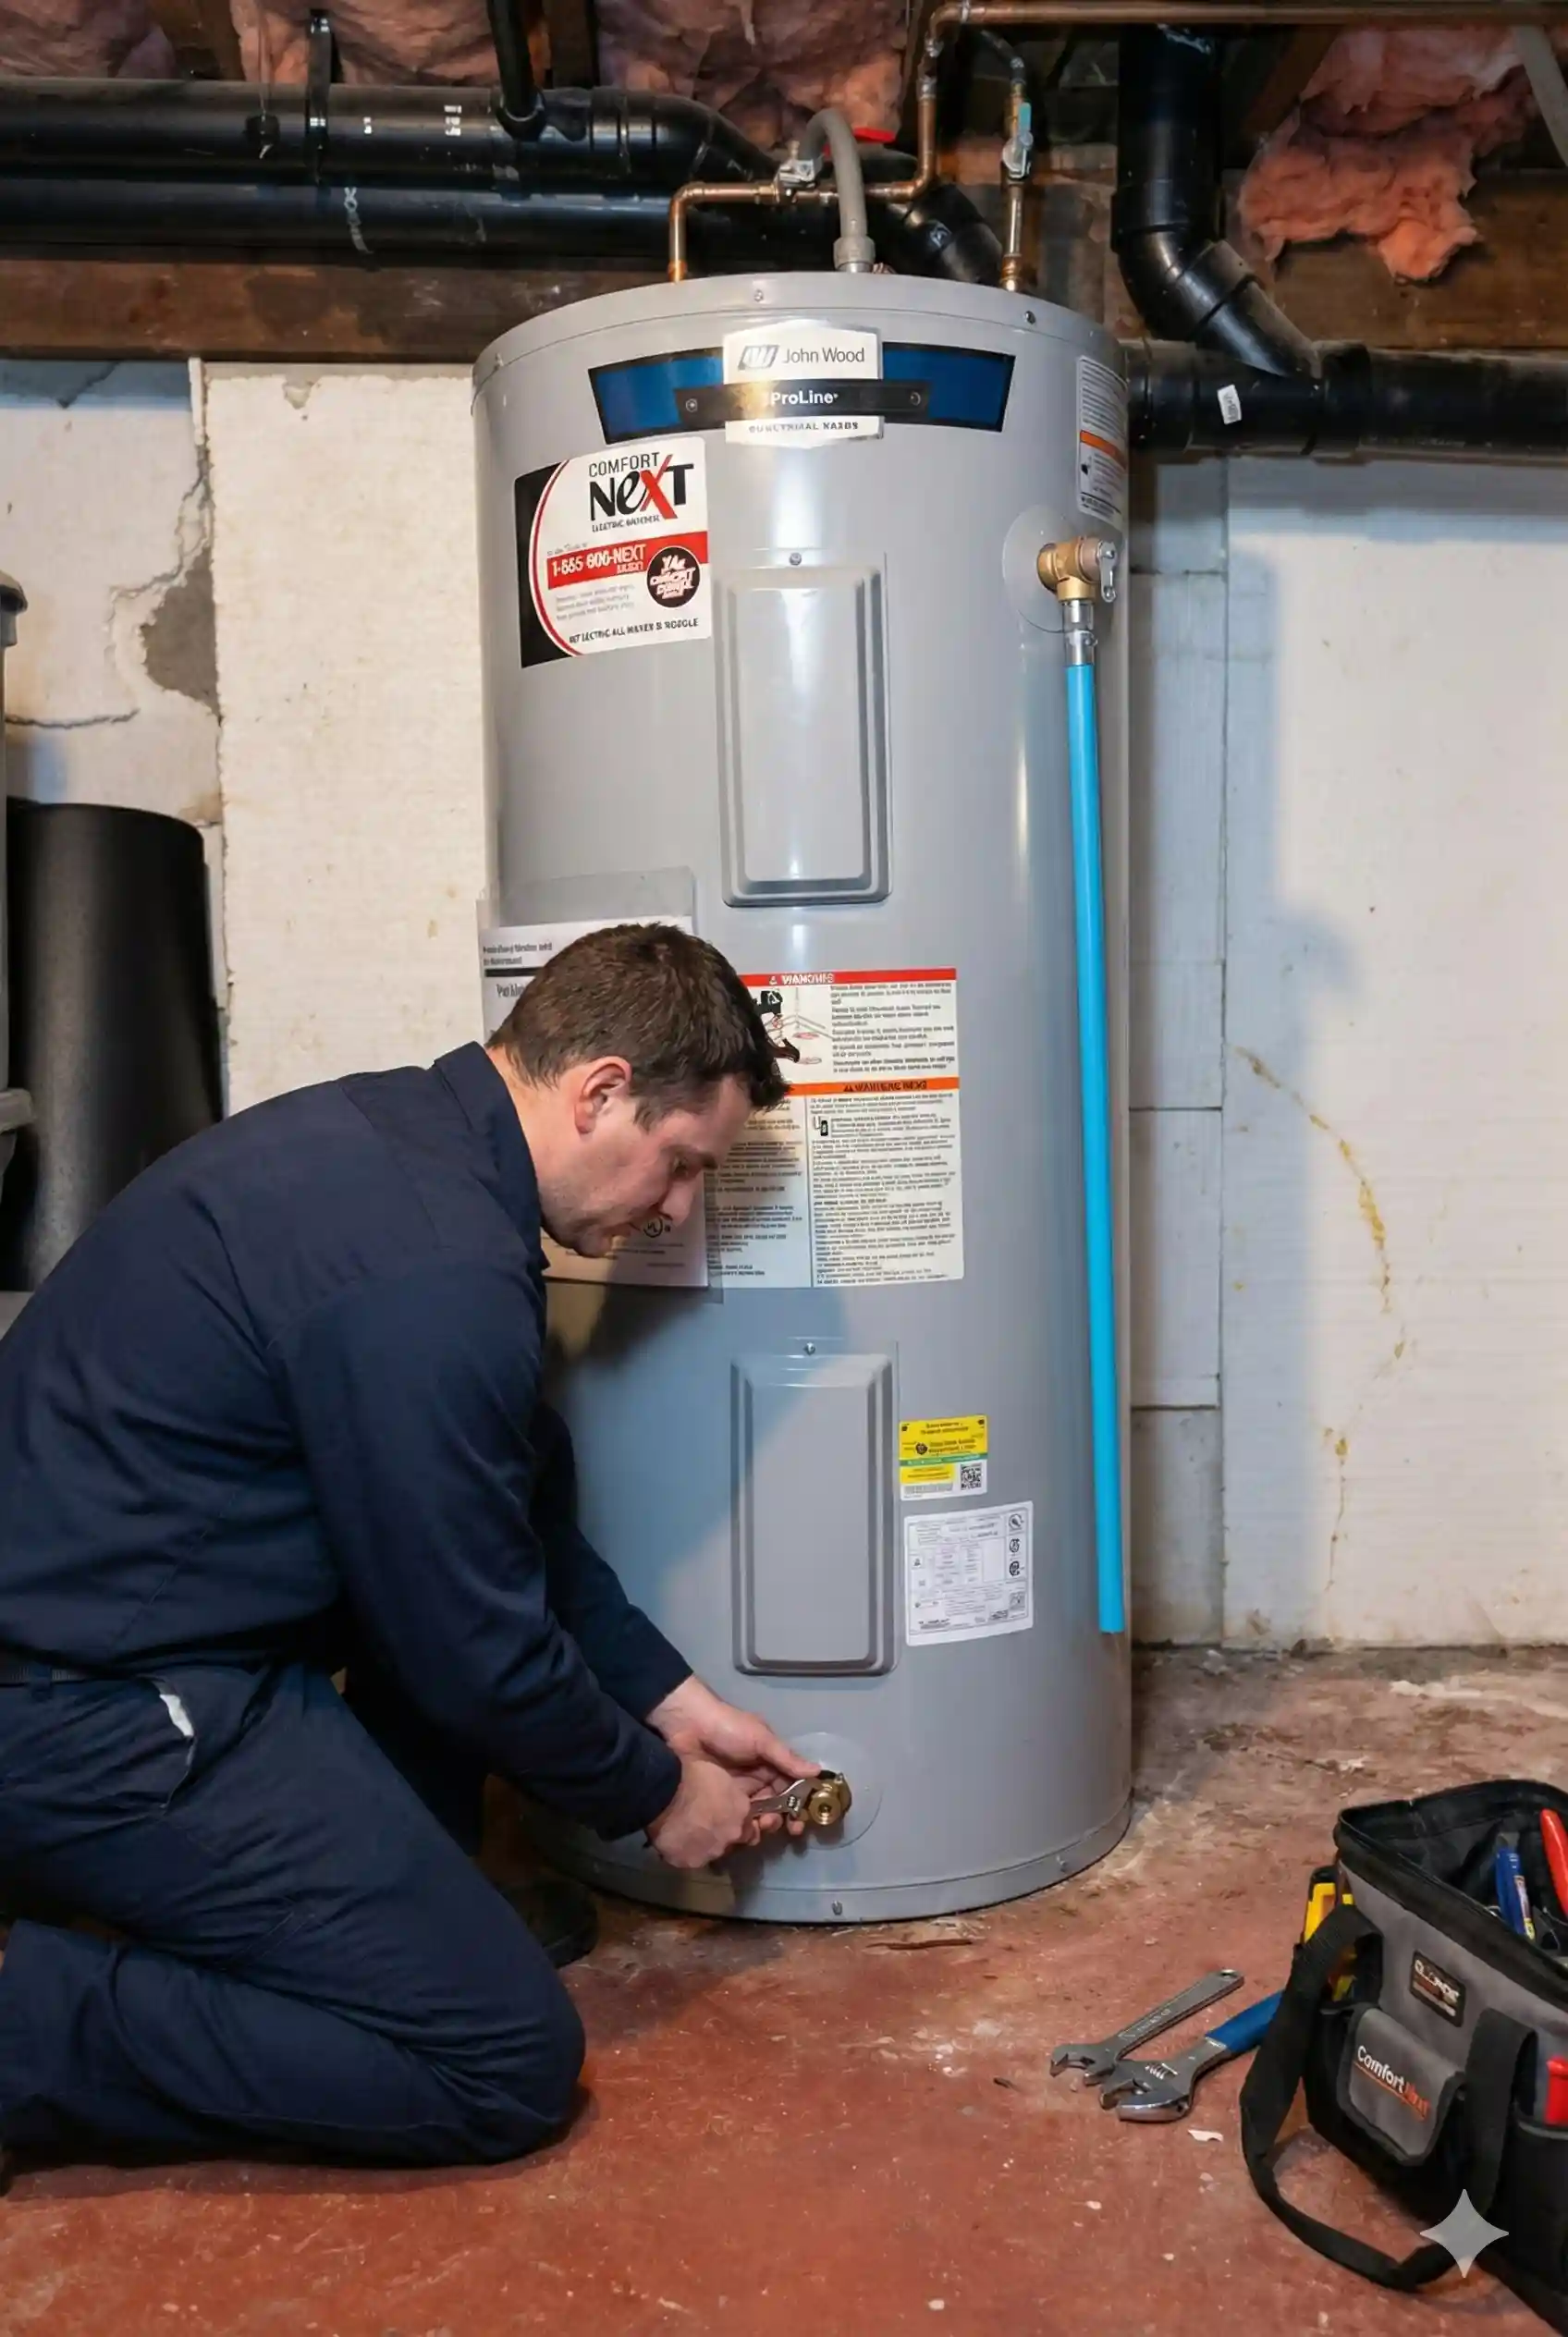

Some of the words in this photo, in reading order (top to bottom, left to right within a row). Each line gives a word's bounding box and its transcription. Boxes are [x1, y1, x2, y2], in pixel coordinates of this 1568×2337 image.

[783, 348, 819, 363] John
[822, 347, 865, 362] Wood
[588, 452, 660, 478] COMFORT
